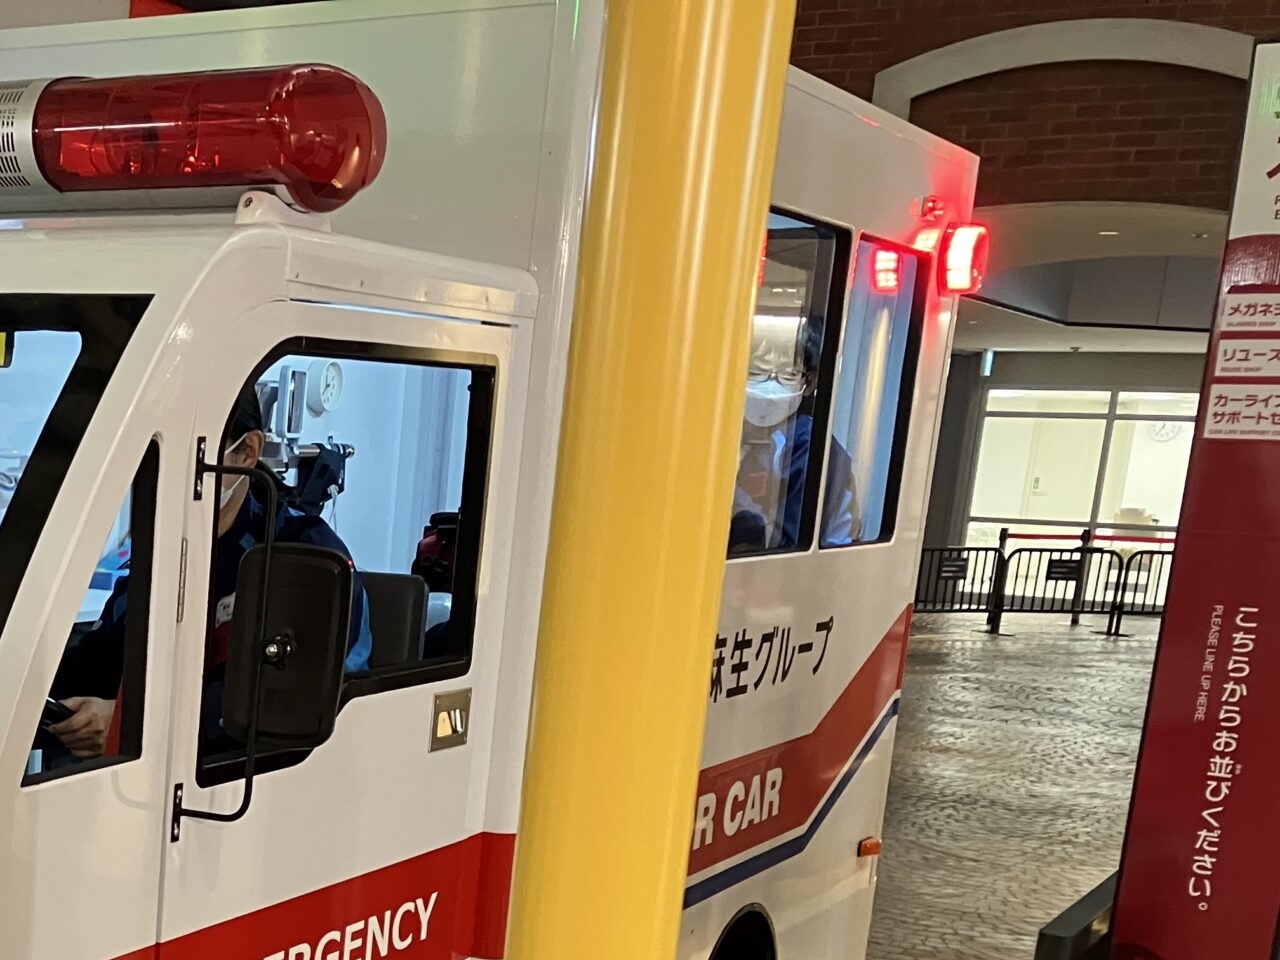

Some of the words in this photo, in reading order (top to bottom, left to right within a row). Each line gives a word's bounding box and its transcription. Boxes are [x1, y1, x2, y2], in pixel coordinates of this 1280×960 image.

[1207, 604, 1224, 646] PLEASE
[1203, 649, 1216, 672] LINE
[1200, 675, 1211, 690] UP
[1188, 607, 1260, 910] こちらからお並びください。
[723, 767, 783, 837] CAR
